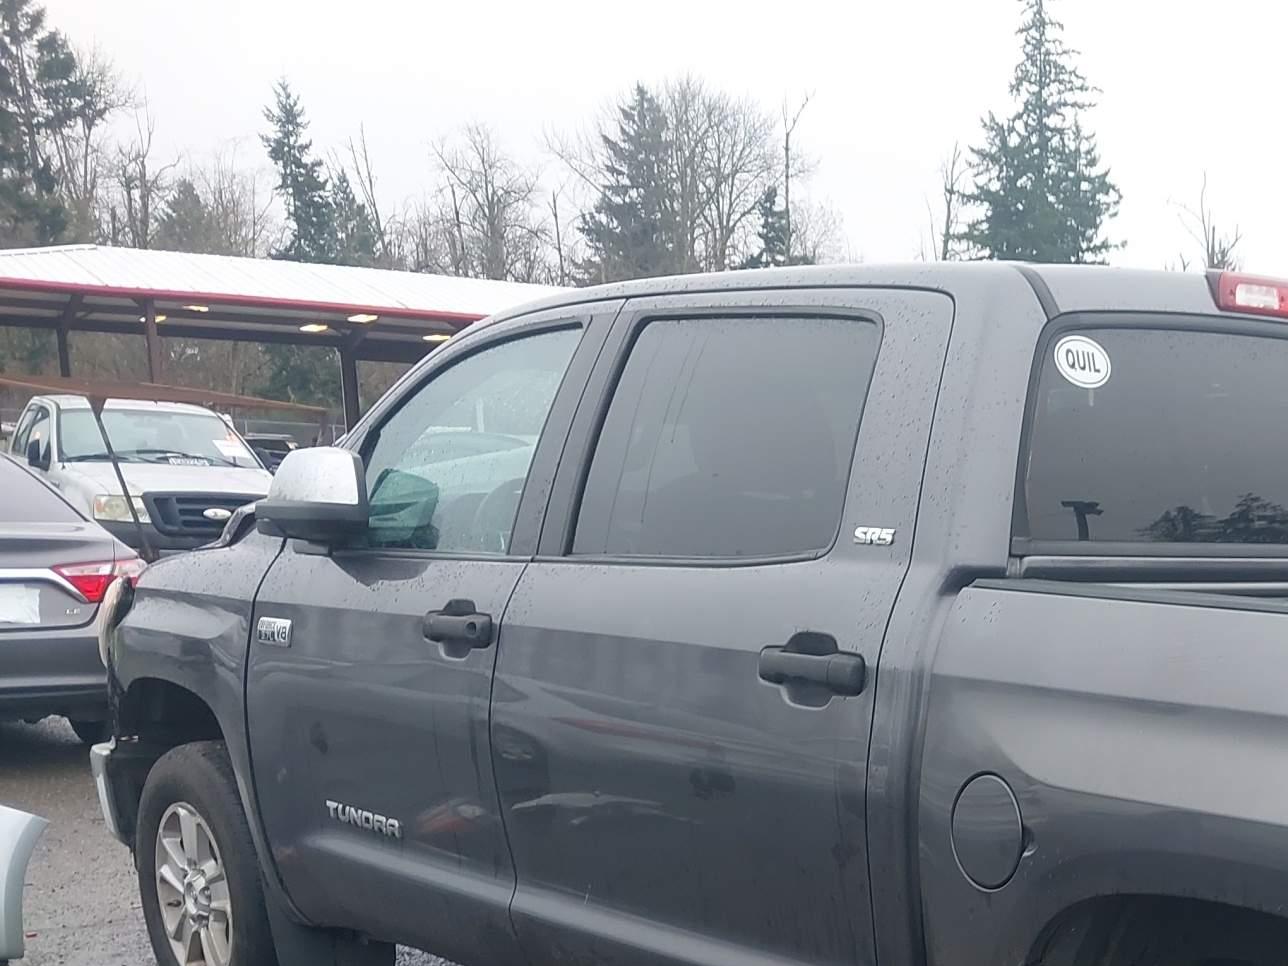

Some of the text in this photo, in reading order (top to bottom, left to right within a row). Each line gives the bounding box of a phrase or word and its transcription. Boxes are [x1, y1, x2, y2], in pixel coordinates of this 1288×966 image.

[1066, 348, 1101, 373] QUIL
[853, 526, 896, 545] SR5
[326, 799, 402, 840] TUNDRA
